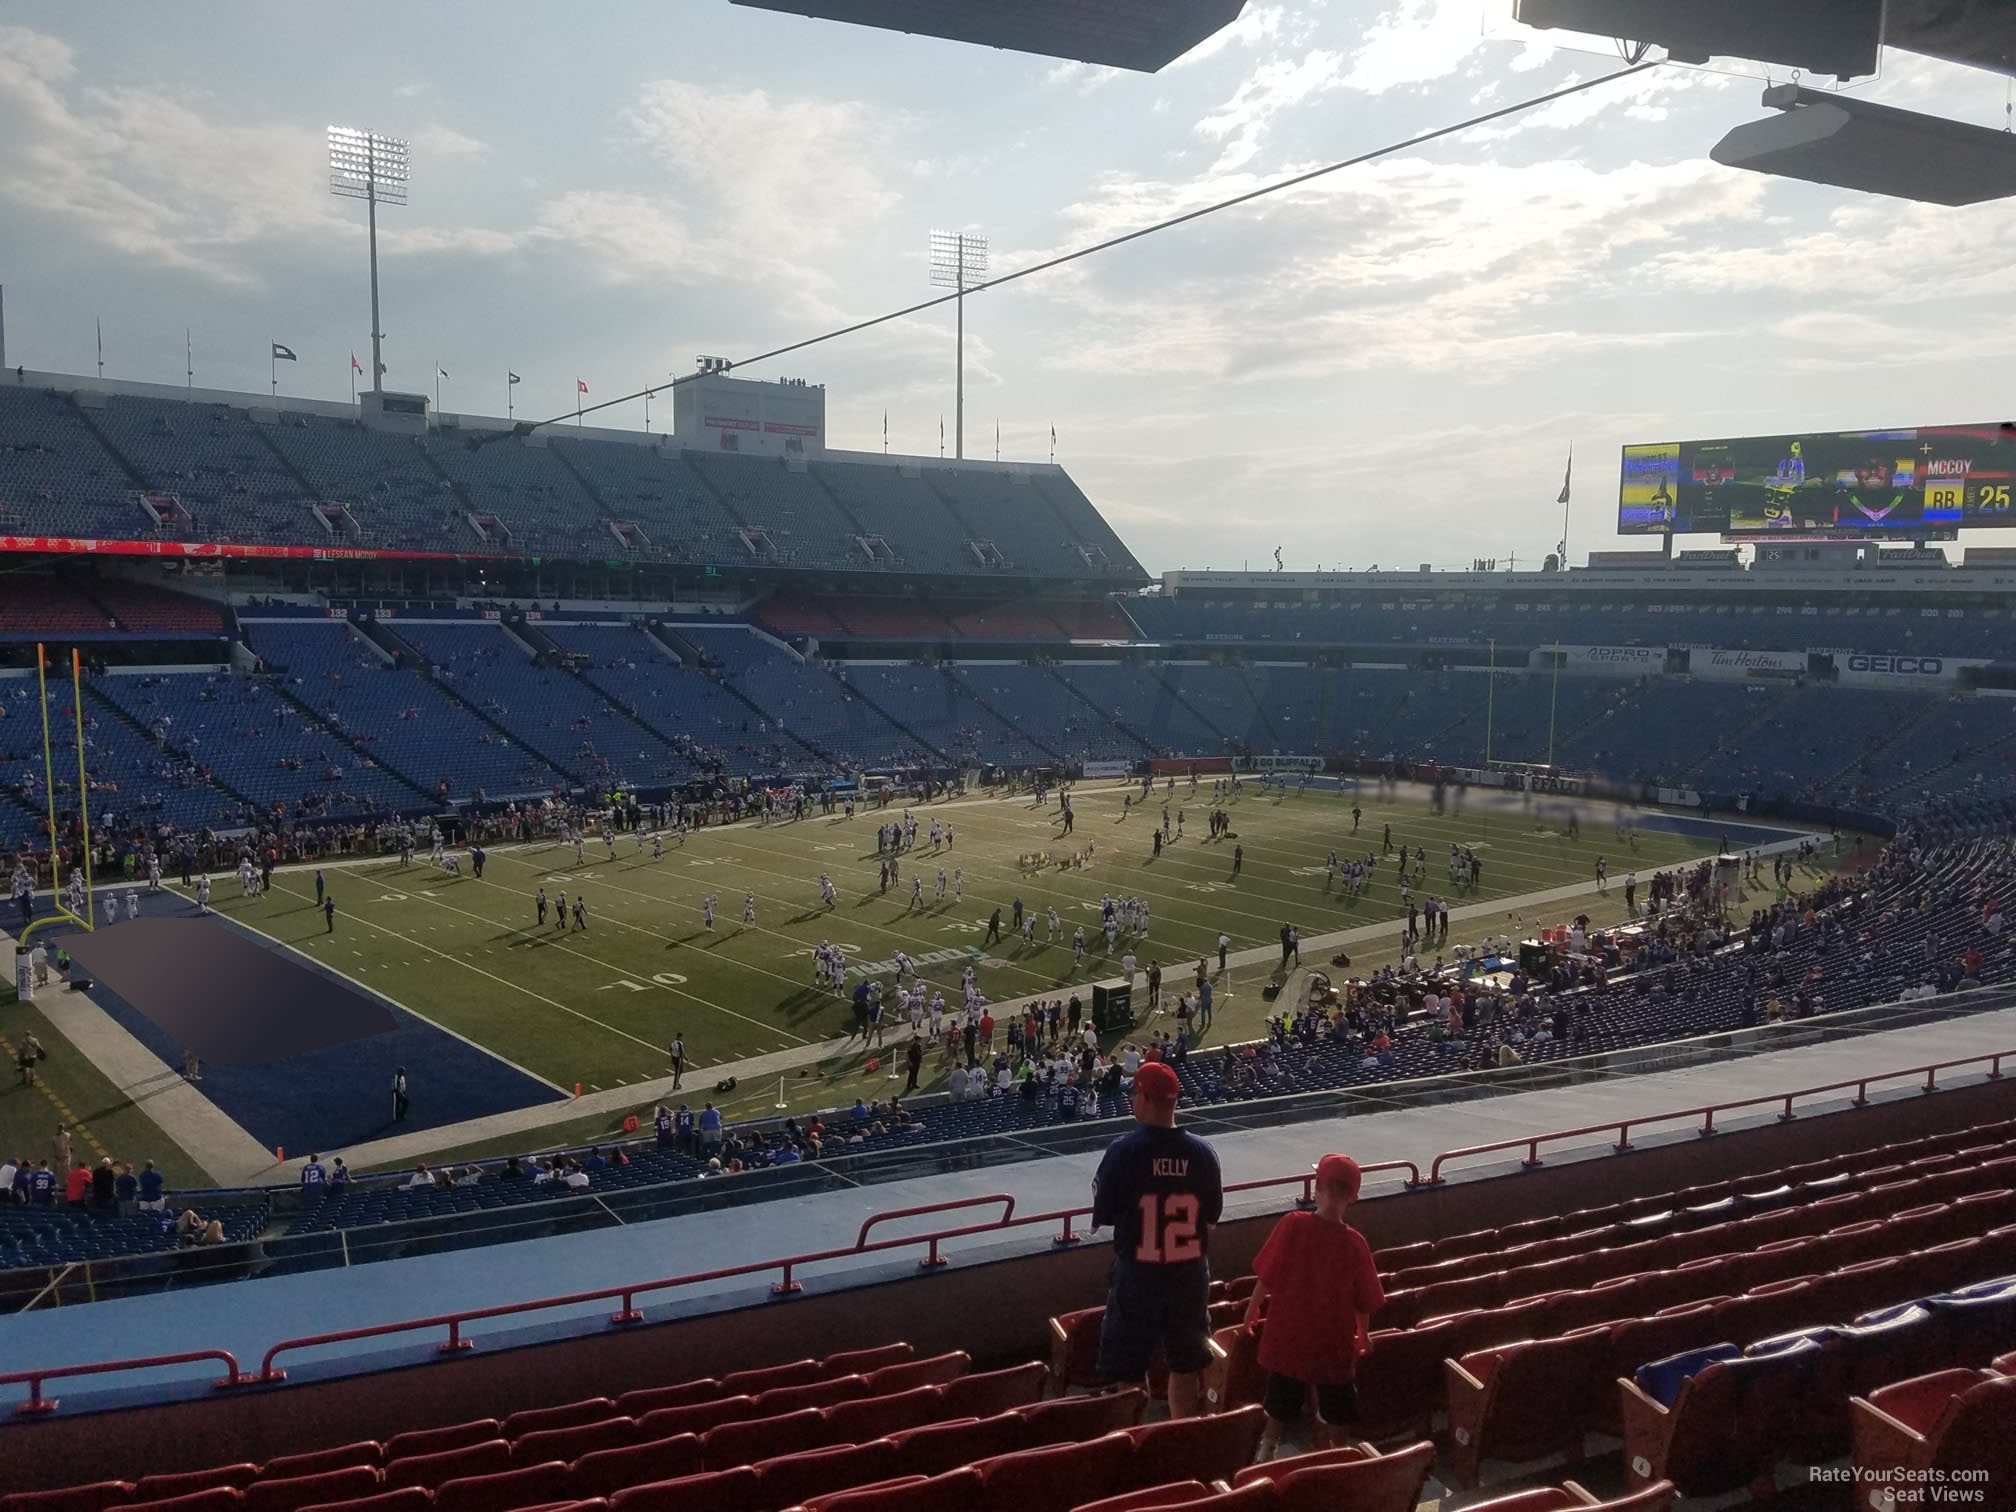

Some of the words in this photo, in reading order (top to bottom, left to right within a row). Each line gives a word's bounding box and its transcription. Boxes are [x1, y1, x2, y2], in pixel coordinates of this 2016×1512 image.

[1927, 459, 1972, 475] MCCOY
[1933, 490, 1955, 509] RB
[1979, 485, 2011, 513] 25
[1768, 551, 1780, 561] 25
[330, 609, 347, 618] 132
[375, 609, 392, 618] 133
[484, 611, 501, 620] 133
[1848, 655, 1943, 674] GEICO
[680, 1116, 690, 1126] 14
[1152, 1158, 1190, 1177] KELLY
[36, 1178, 50, 1190] 99
[304, 1169, 320, 1184] 12
[1135, 1193, 1202, 1264] 12
